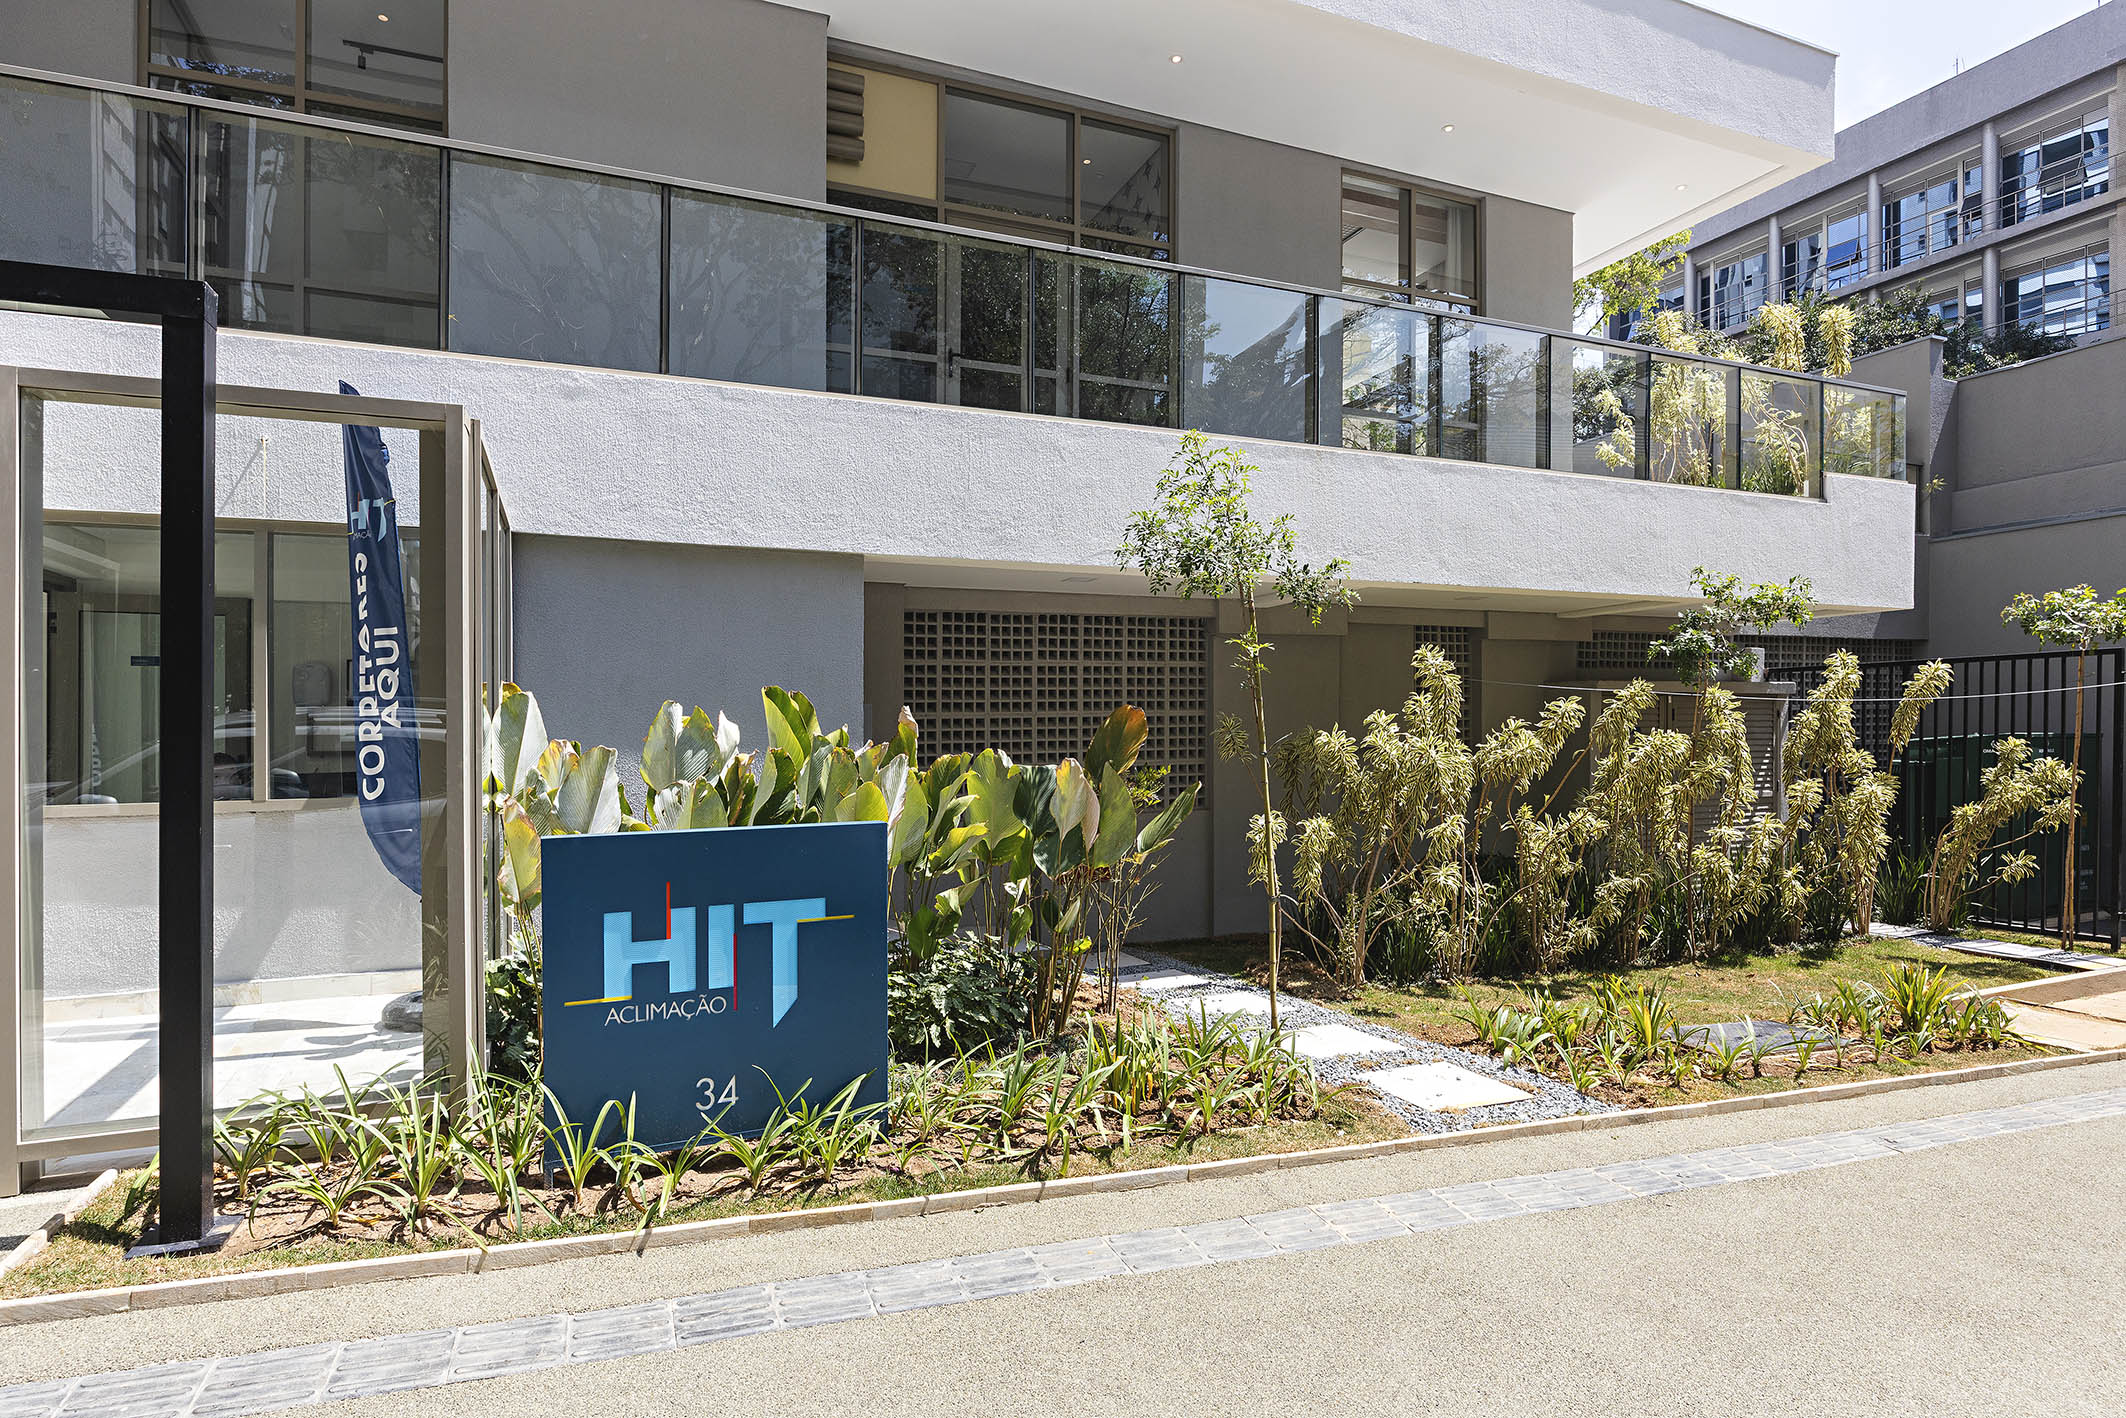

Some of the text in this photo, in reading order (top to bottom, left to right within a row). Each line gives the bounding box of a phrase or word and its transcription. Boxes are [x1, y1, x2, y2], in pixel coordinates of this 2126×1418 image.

[373, 626, 402, 729] AQUI
[603, 897, 827, 1029] HIT
[604, 993, 728, 1027] ACLIMAÇÃO
[695, 1074, 740, 1112] 34
